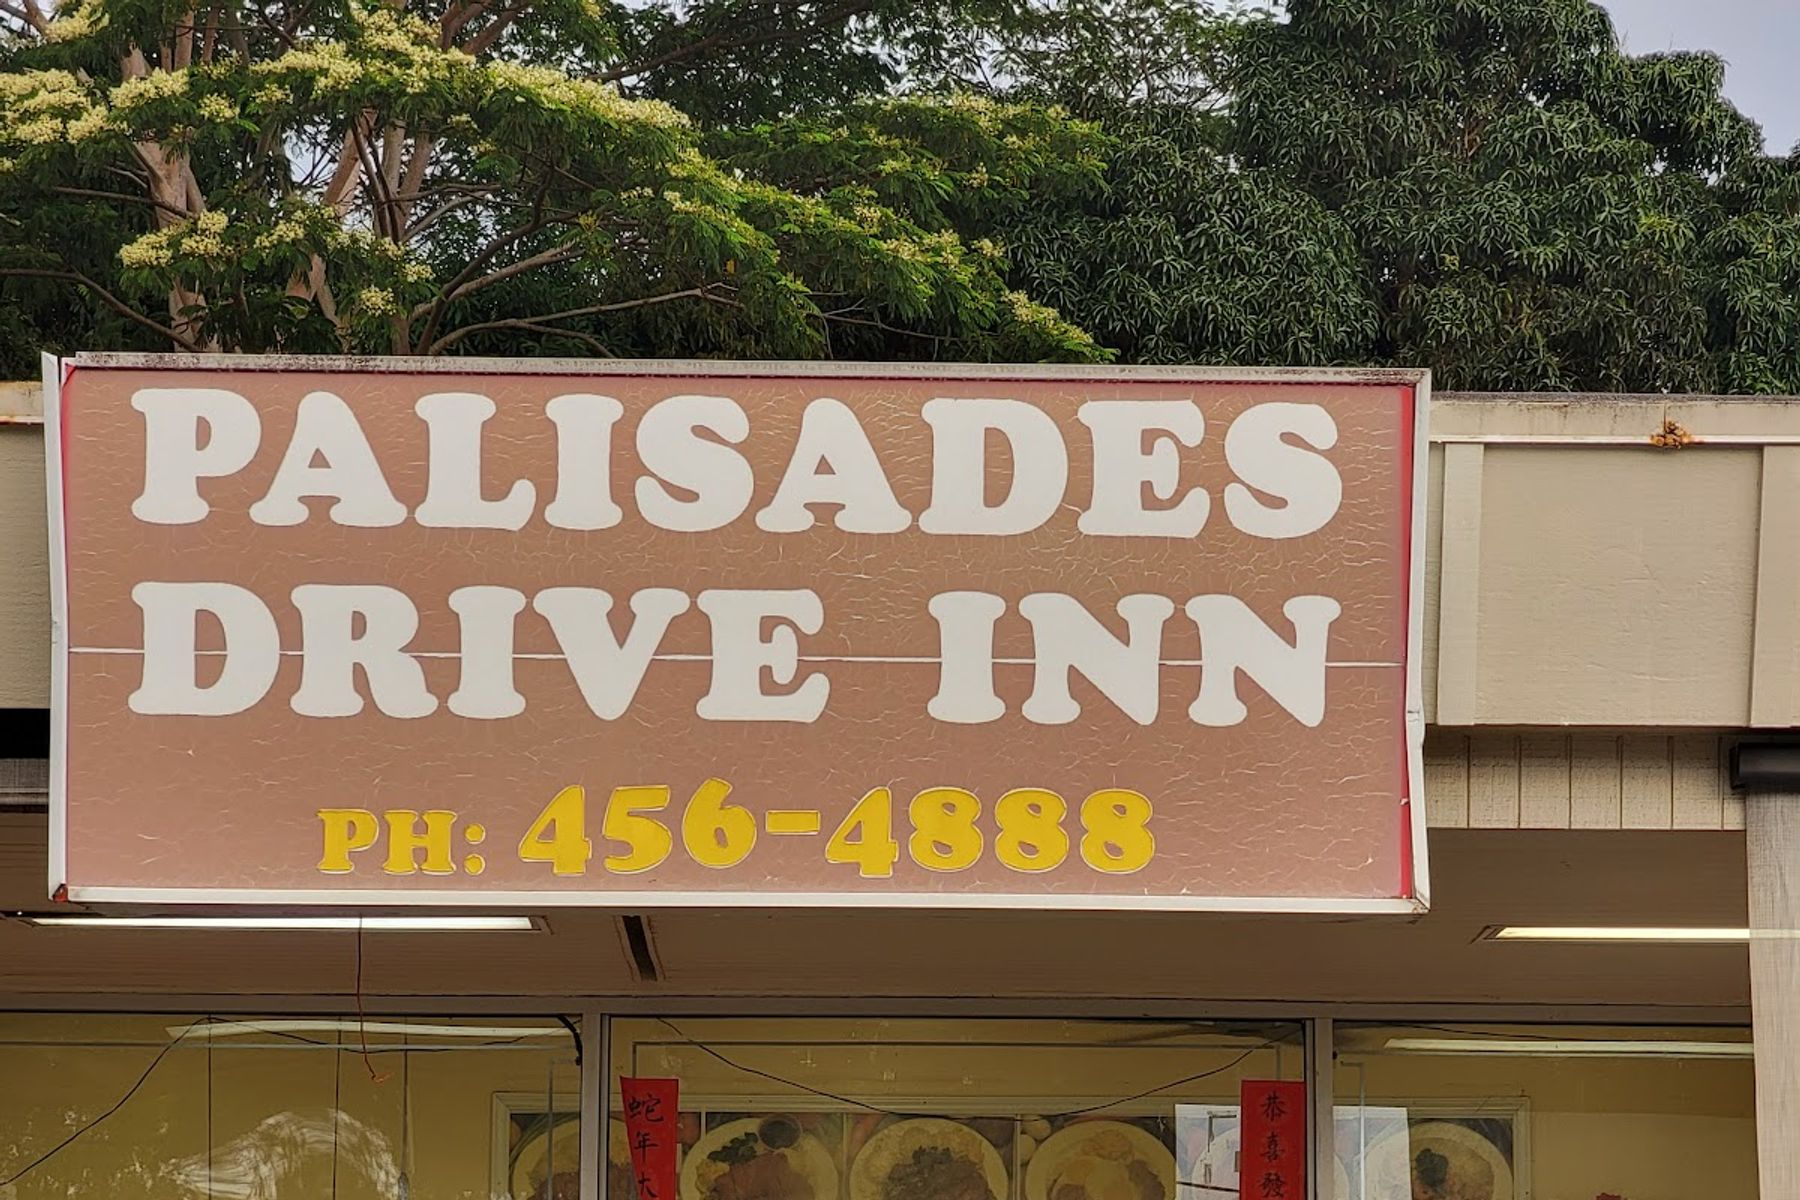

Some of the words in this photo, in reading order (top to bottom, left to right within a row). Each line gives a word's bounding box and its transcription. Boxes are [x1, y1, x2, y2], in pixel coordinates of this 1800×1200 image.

[130, 387, 1343, 539] PALISADES
[128, 581, 831, 723] DRIVE
[926, 591, 1342, 728] INN
[316, 807, 487, 877] PH:
[517, 777, 1155, 878] 456-4888
